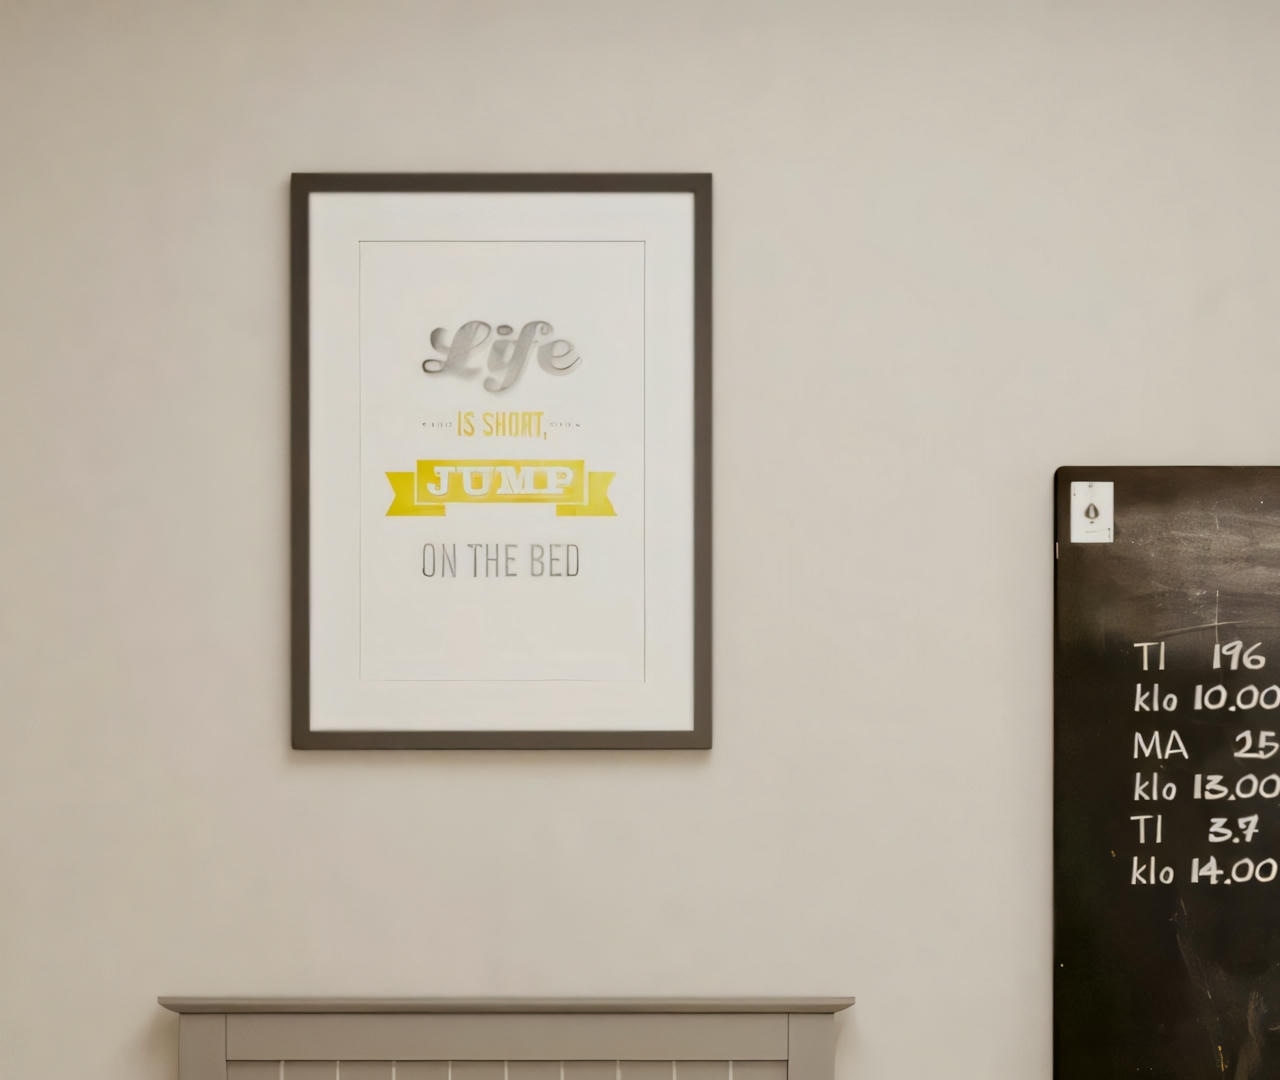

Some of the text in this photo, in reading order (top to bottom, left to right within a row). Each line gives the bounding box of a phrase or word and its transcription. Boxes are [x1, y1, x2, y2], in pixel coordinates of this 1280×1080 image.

[421, 320, 581, 394] Life
[457, 410, 548, 441] IS SHORT,
[426, 465, 575, 497] JUMP
[421, 543, 580, 578] ON THE BED
[1133, 641, 1165, 671] TI
[1134, 683, 1178, 712] klo
[1133, 729, 1189, 760] MA
[1134, 772, 1177, 801] klo
[1130, 814, 1259, 844] TI 3.7
[1131, 855, 1278, 885] klo 14.00
